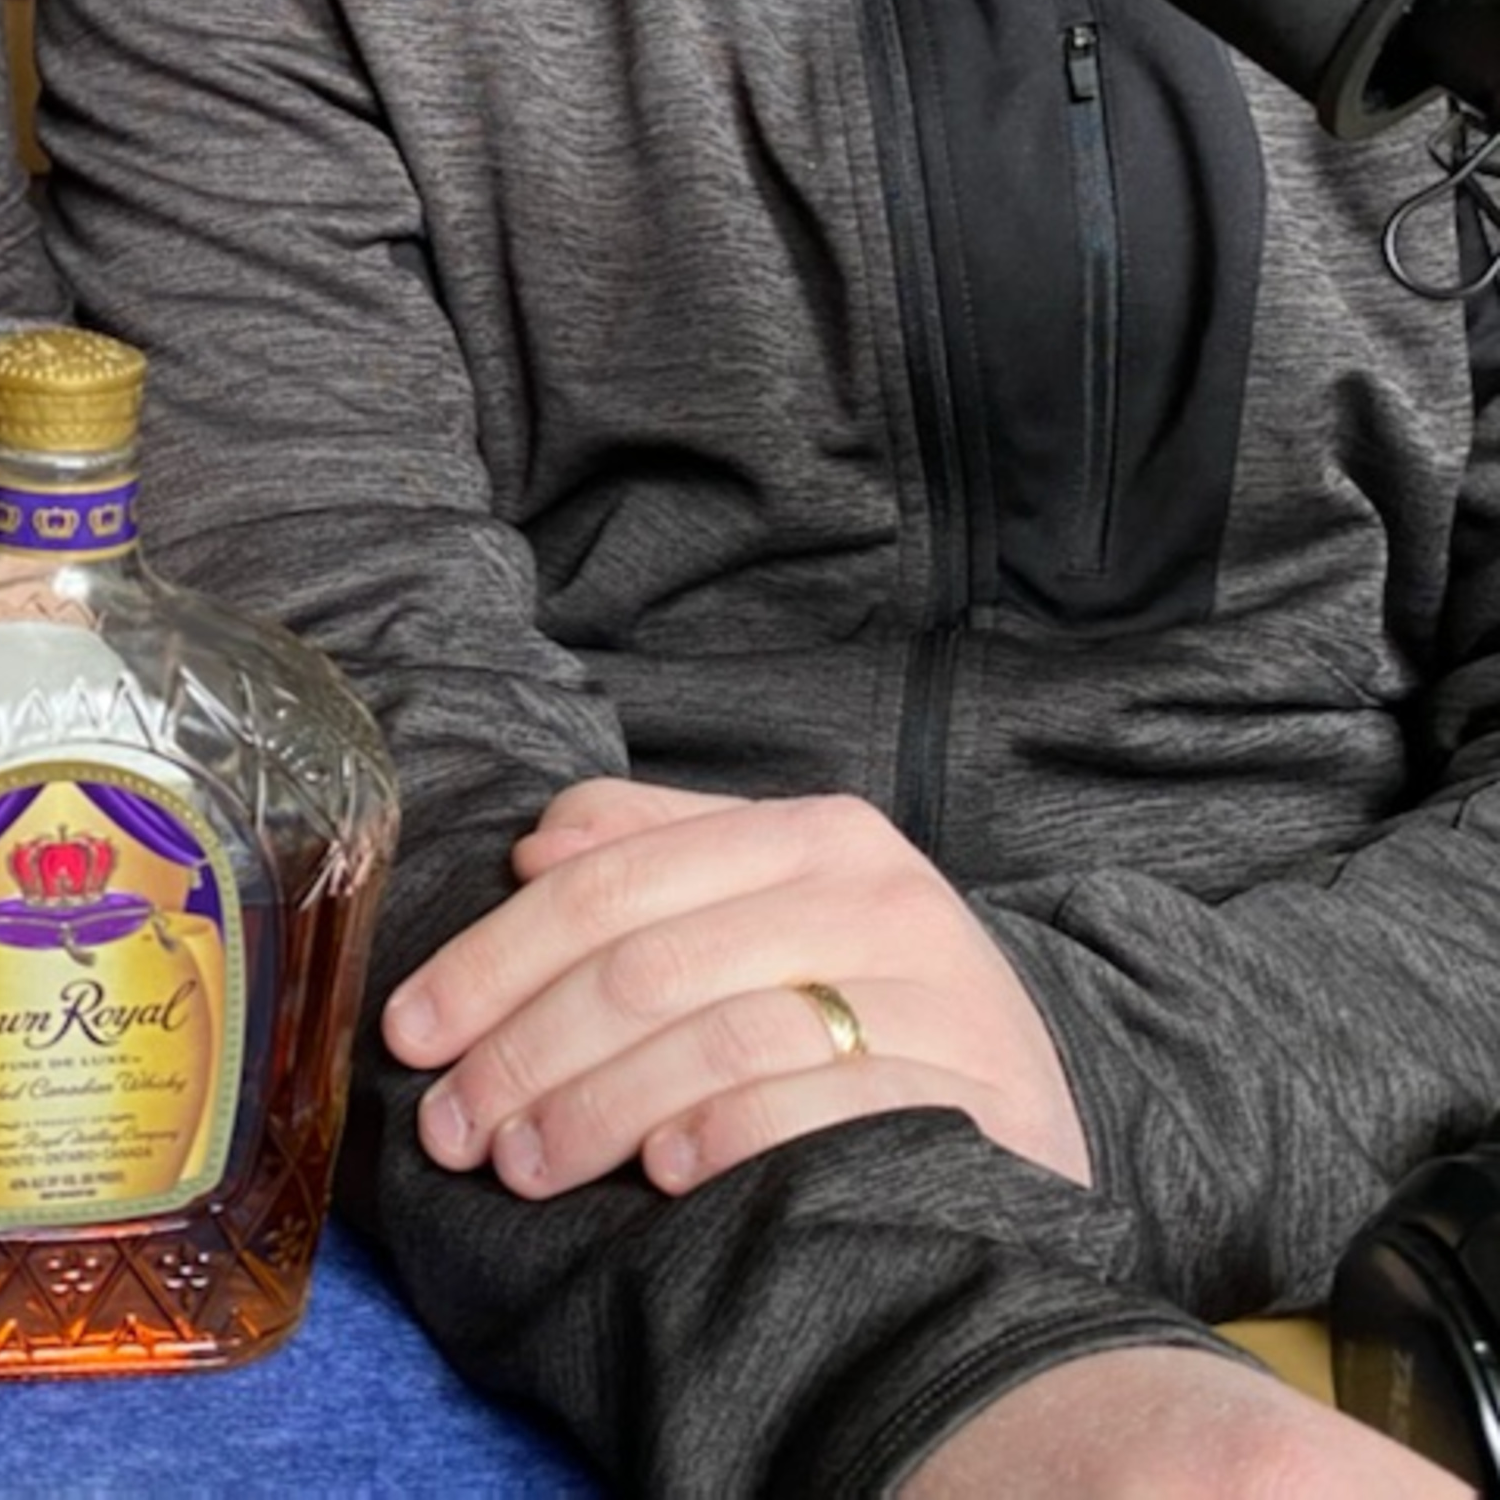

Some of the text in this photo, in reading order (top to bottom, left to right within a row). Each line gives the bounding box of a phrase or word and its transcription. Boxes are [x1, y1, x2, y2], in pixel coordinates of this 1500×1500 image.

[23, 978, 197, 1051] Royal
[29, 1076, 113, 1100] Canadian
[116, 1070, 187, 1095] Whisky
